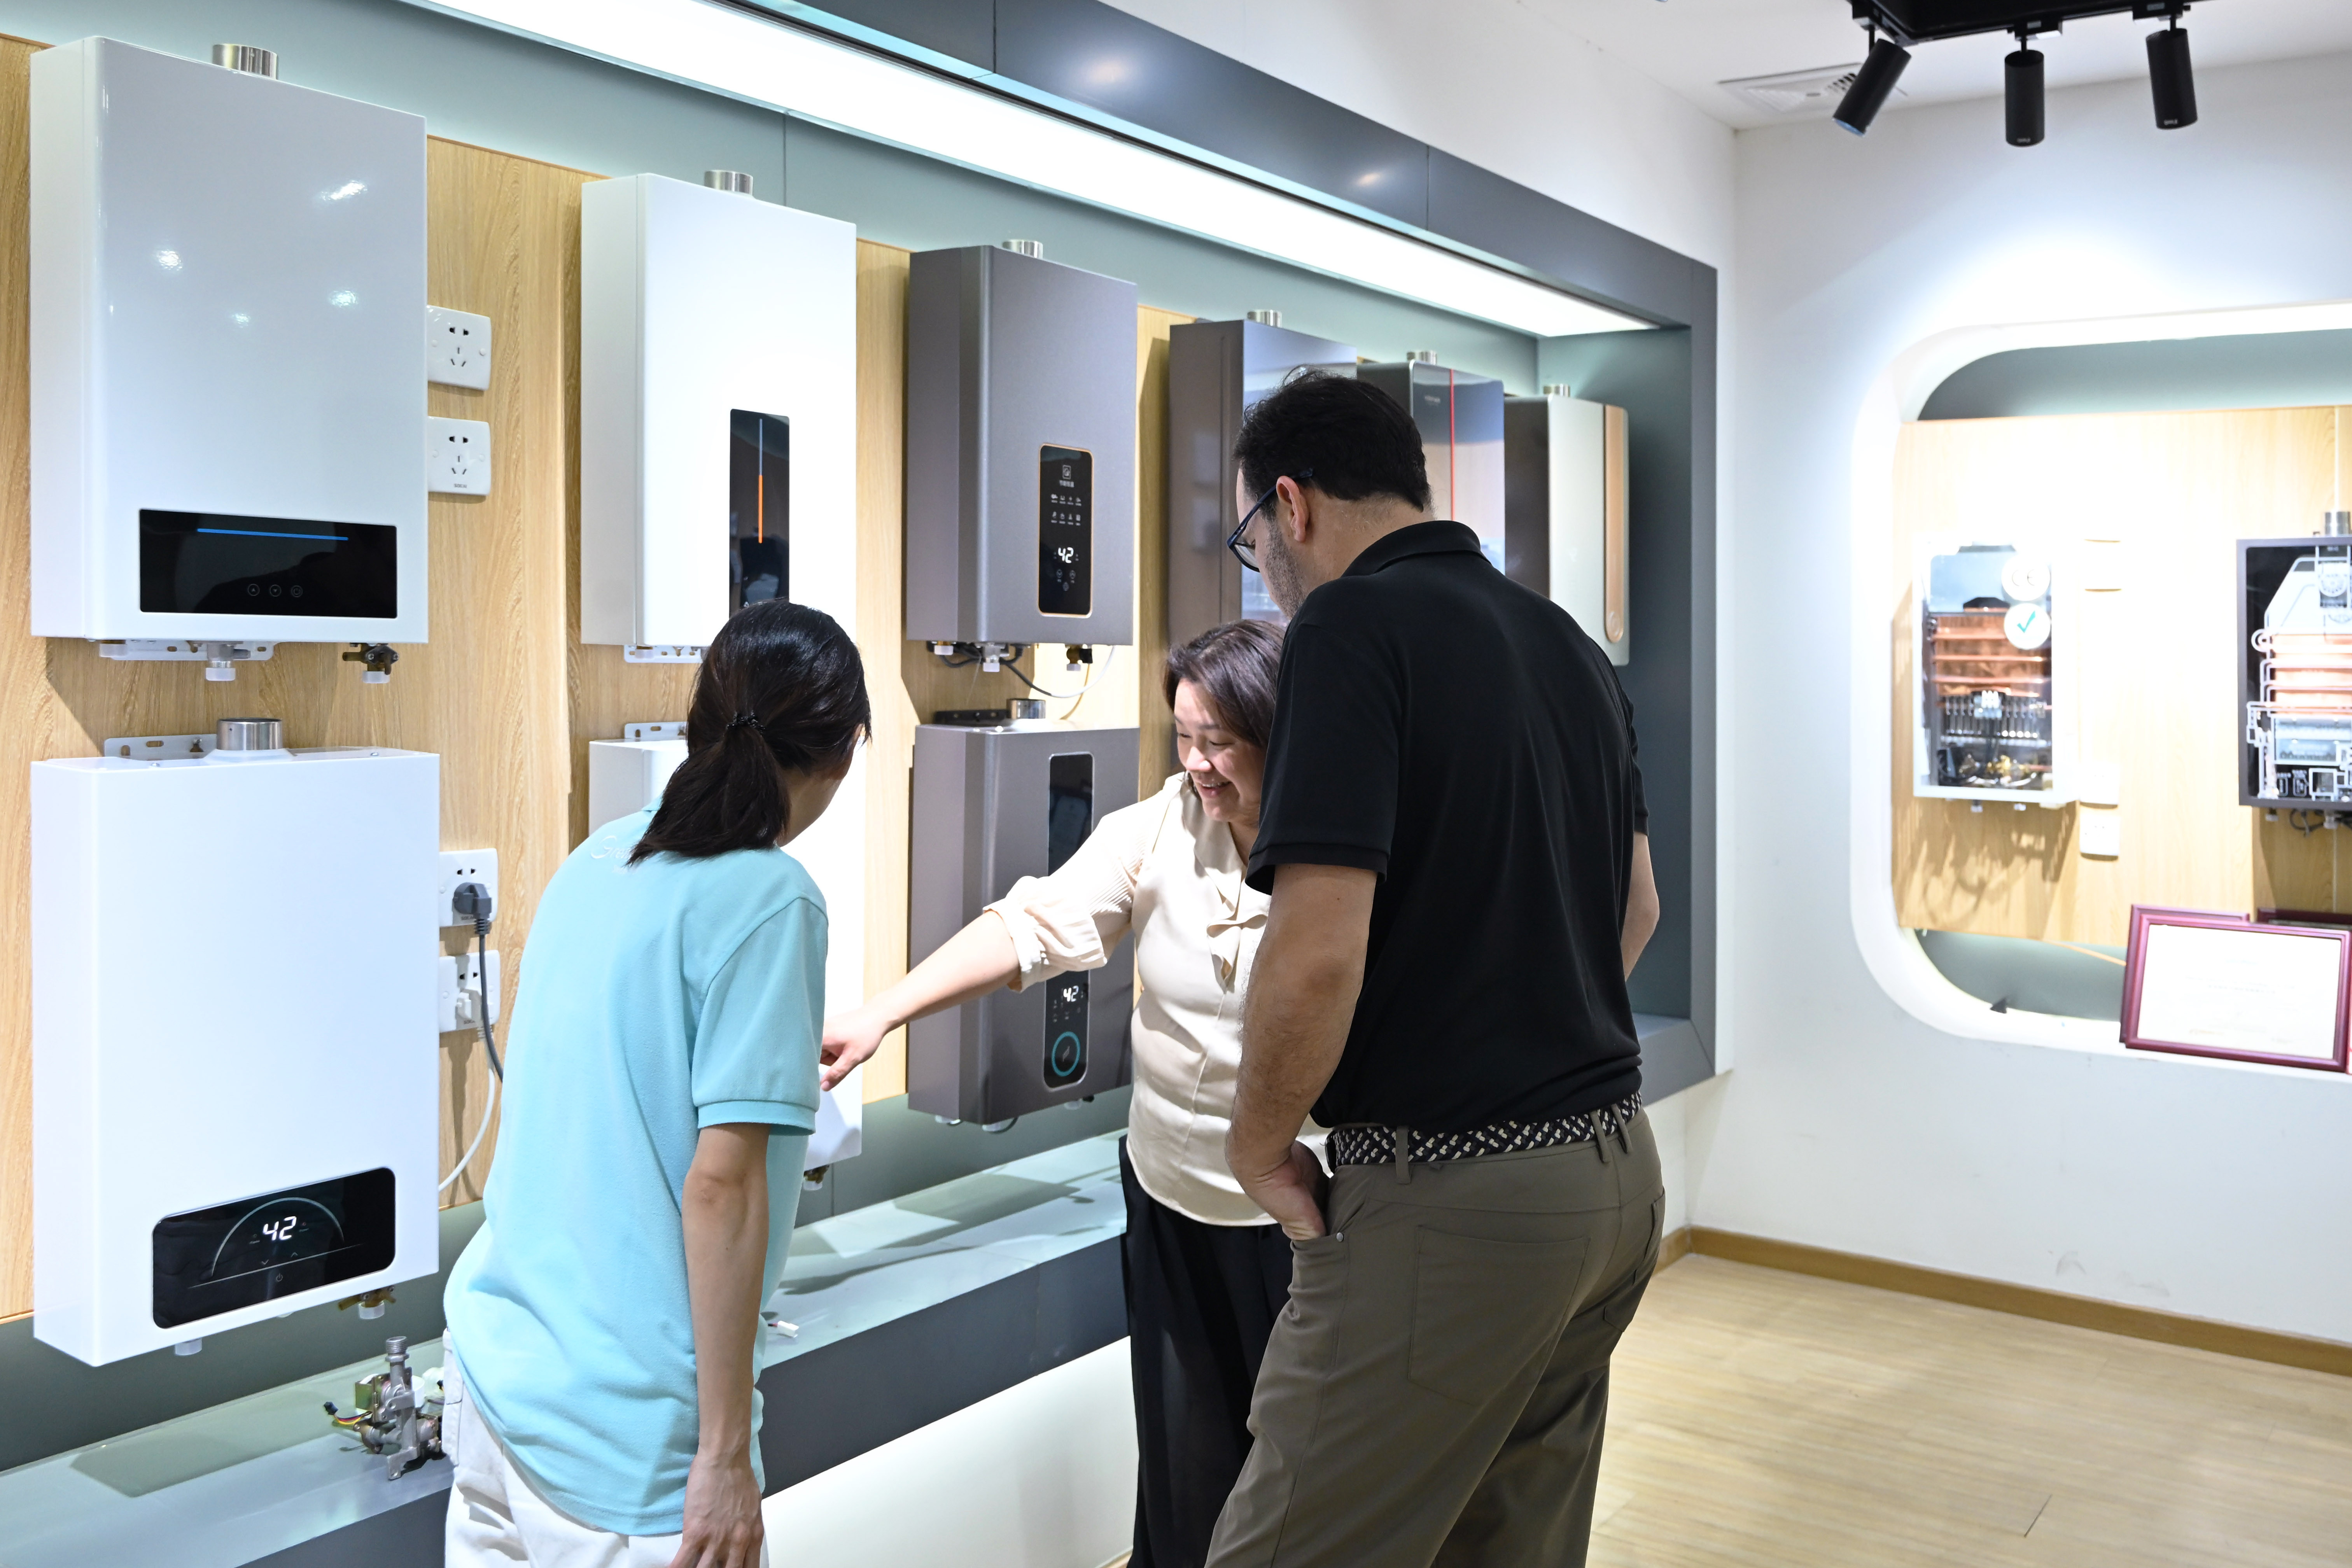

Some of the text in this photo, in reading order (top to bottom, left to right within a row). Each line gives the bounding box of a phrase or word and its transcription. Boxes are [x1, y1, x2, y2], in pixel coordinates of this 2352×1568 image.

[1058, 547, 1074, 564] 42
[1063, 985, 1079, 1002] 42
[262, 1216, 297, 1241] 42
